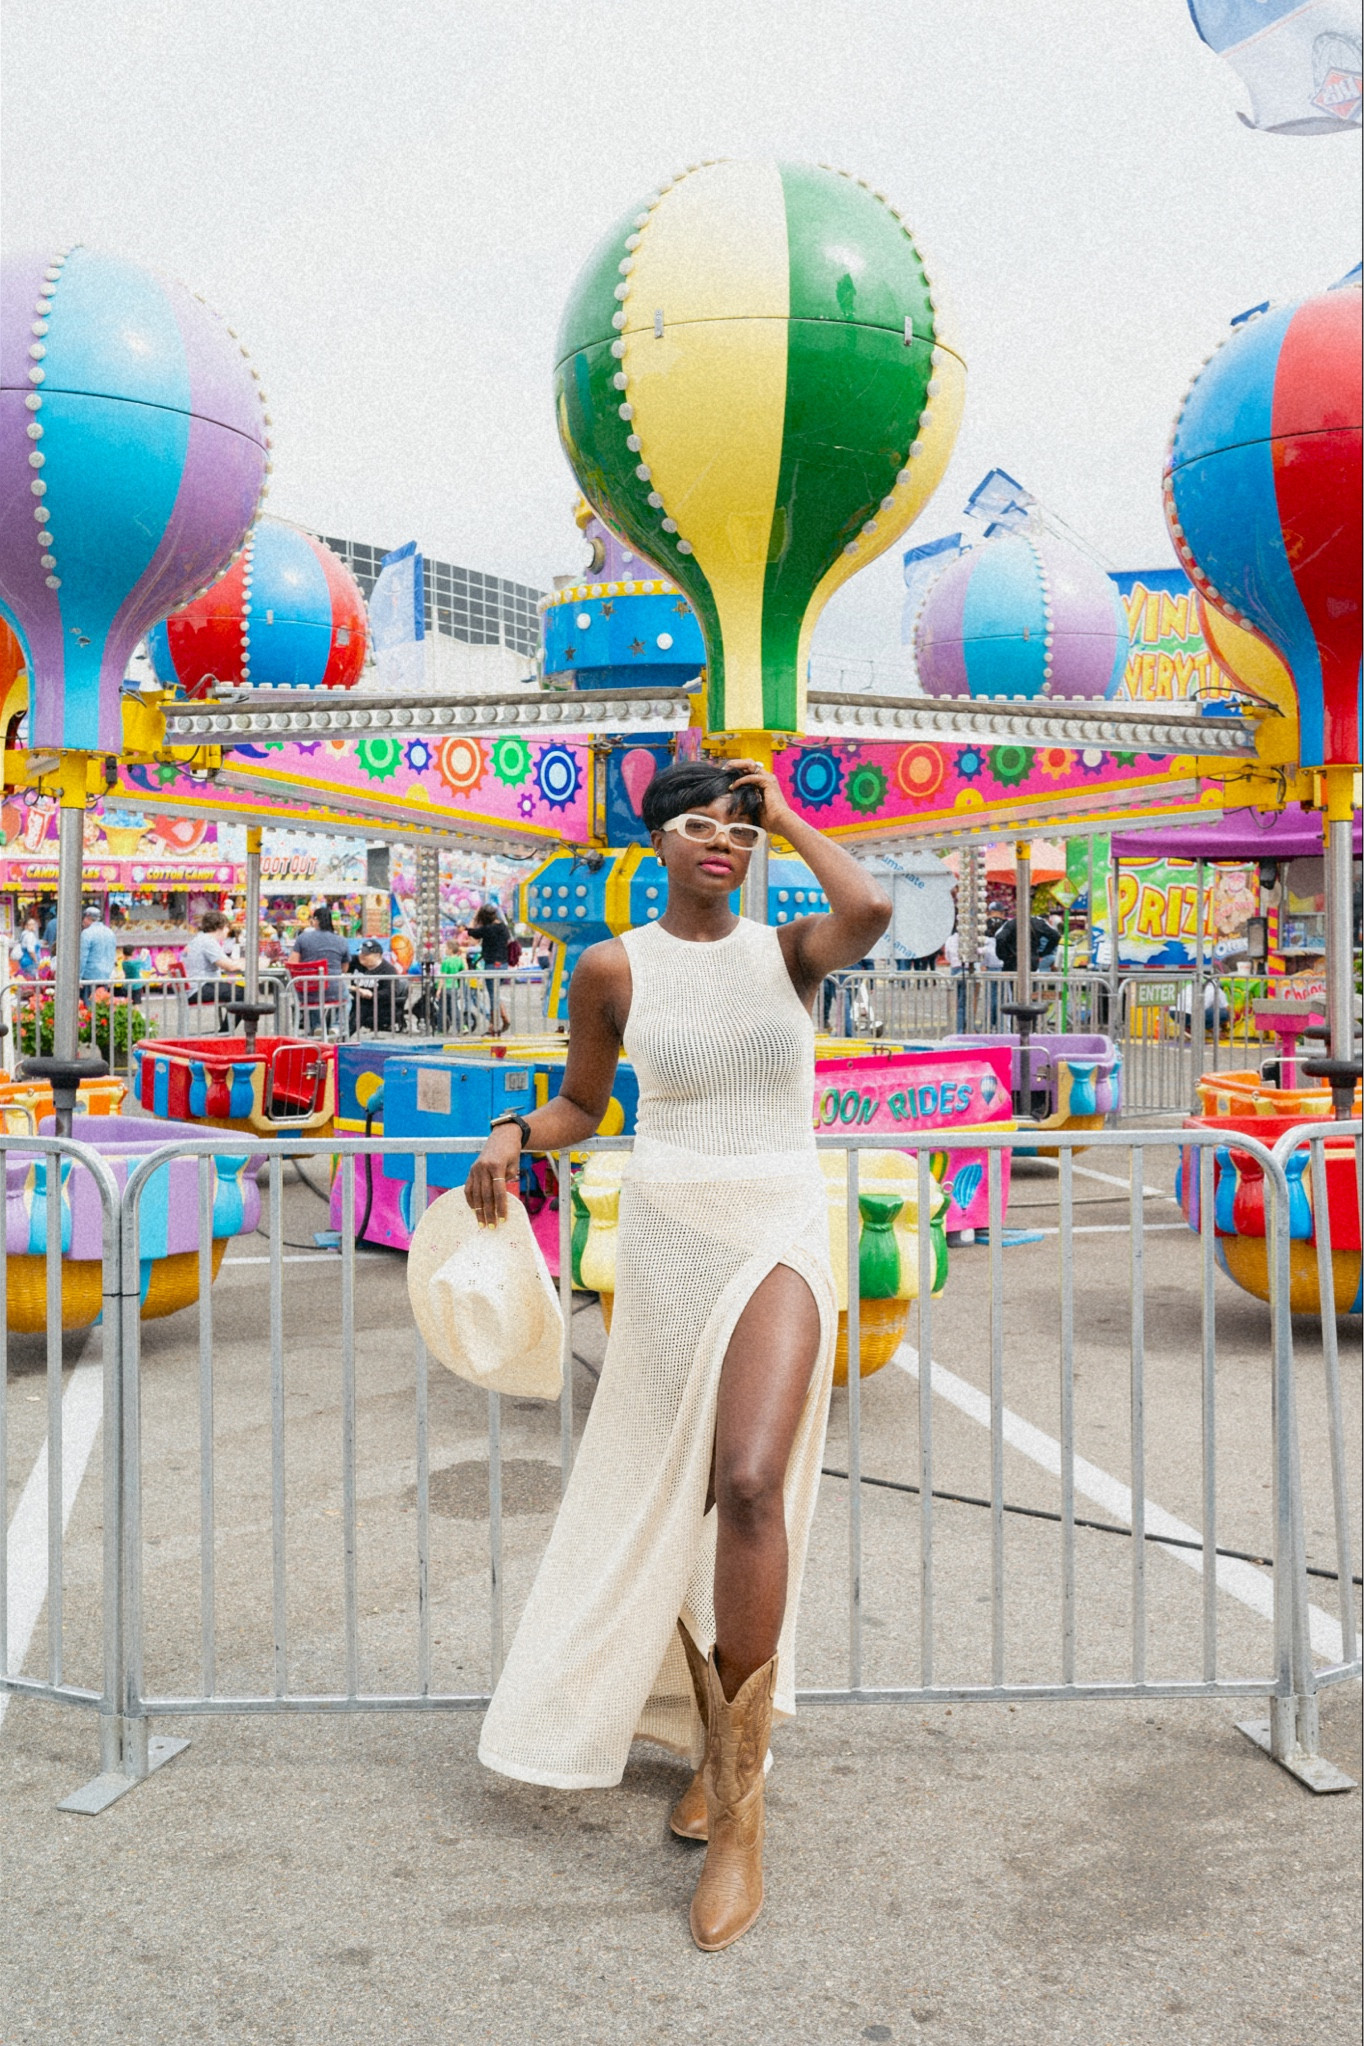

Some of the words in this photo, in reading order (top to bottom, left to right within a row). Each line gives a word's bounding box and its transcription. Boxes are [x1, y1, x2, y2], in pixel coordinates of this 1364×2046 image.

[146, 866, 184, 880] COTTON
[185, 866, 217, 880] CANDY
[260, 855, 288, 875] OOT
[290, 855, 317, 875] OUT
[1139, 983, 1175, 1001] ENTER
[814, 1087, 879, 1125] OON
[887, 1081, 973, 1120] RIDES
